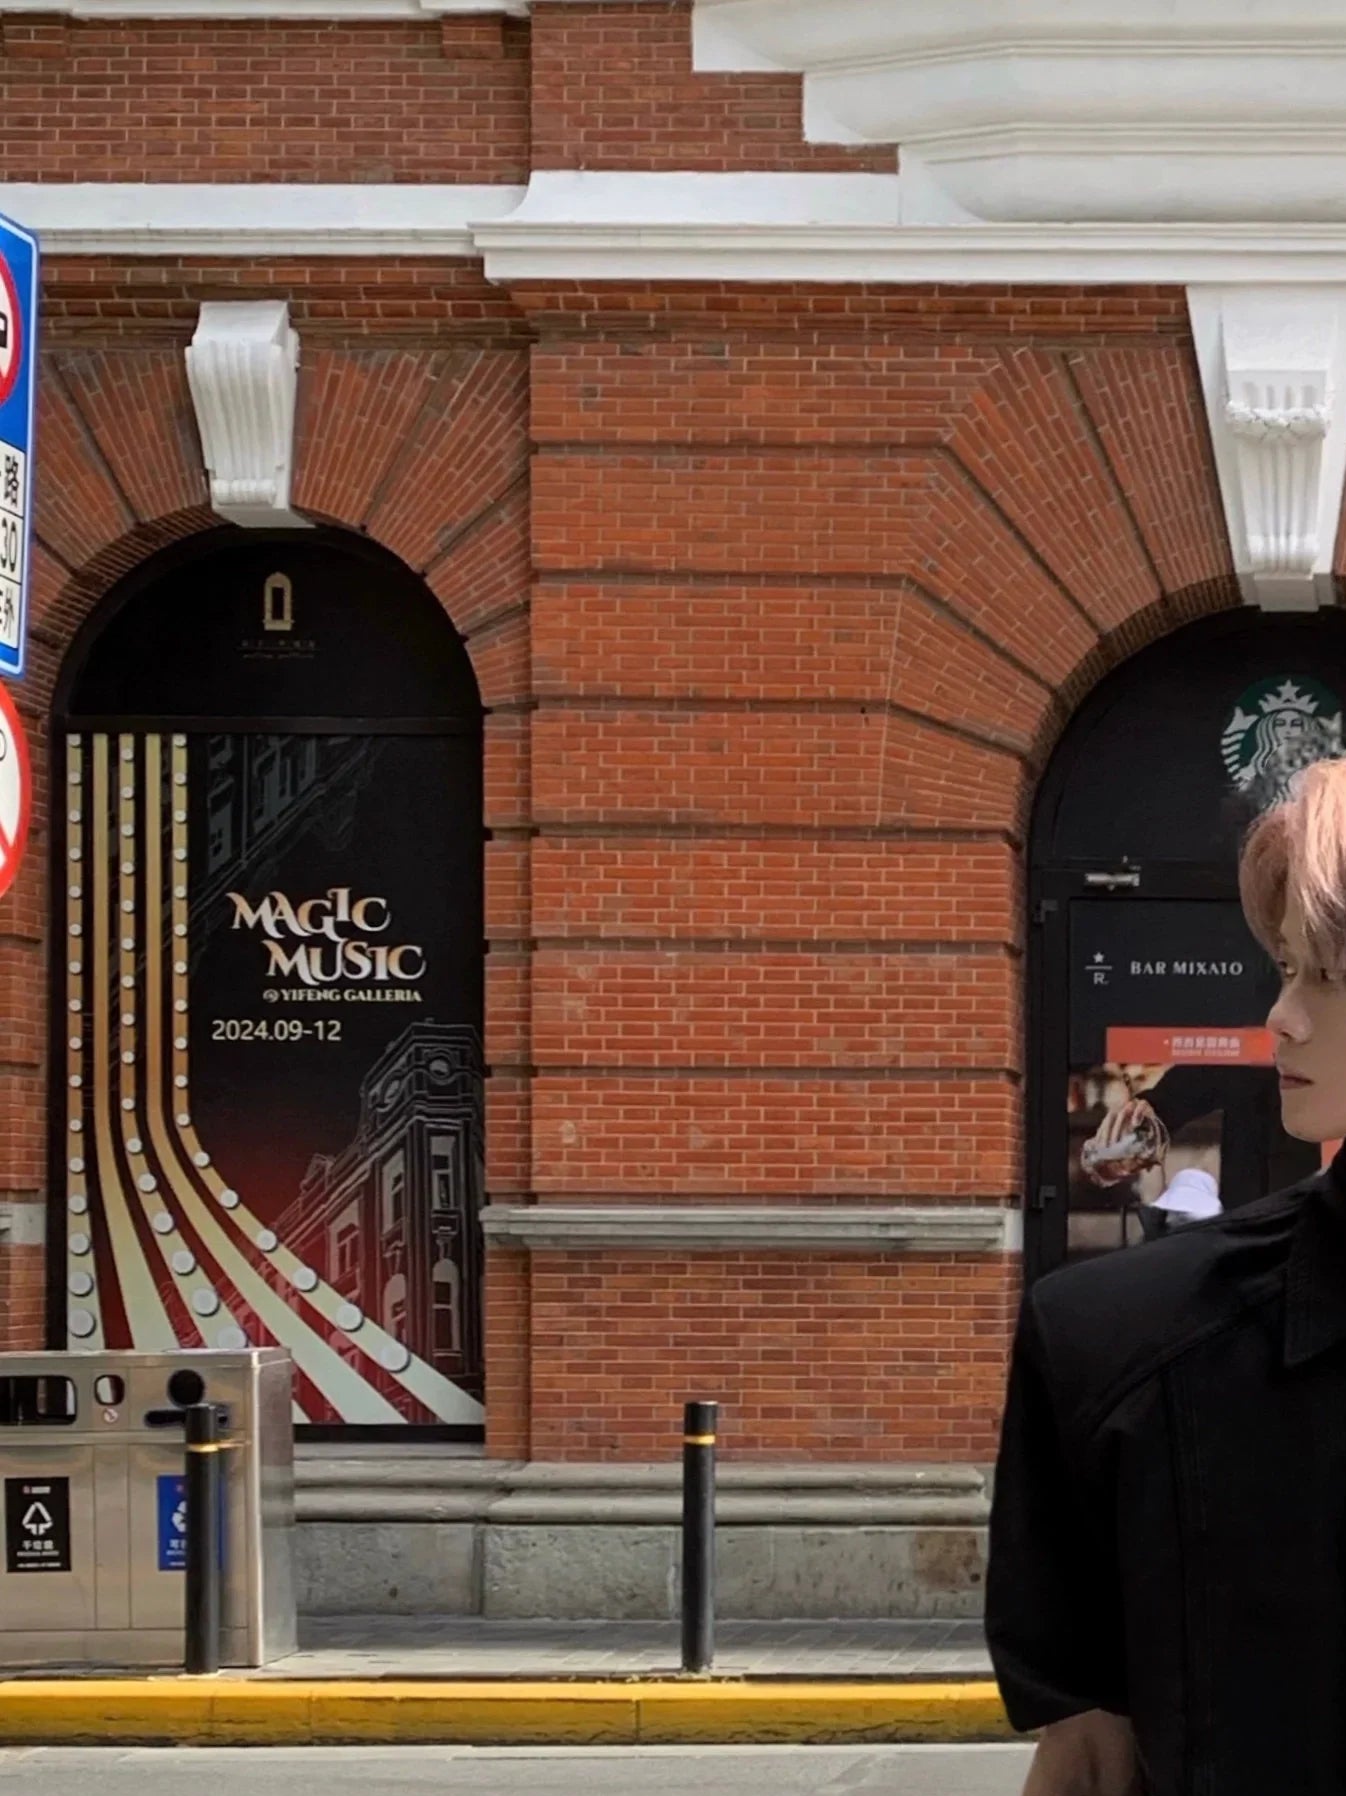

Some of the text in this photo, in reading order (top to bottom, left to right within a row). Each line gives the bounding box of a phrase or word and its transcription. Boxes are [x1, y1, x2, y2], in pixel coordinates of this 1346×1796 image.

[226, 887, 391, 941] MAGIC
[262, 939, 426, 985] MUSIC
[1130, 961, 1166, 975] BAR
[281, 989, 341, 1002] YIFENG
[343, 989, 422, 1002] GALLERIA
[211, 1019, 342, 1041] 2024.09-12
